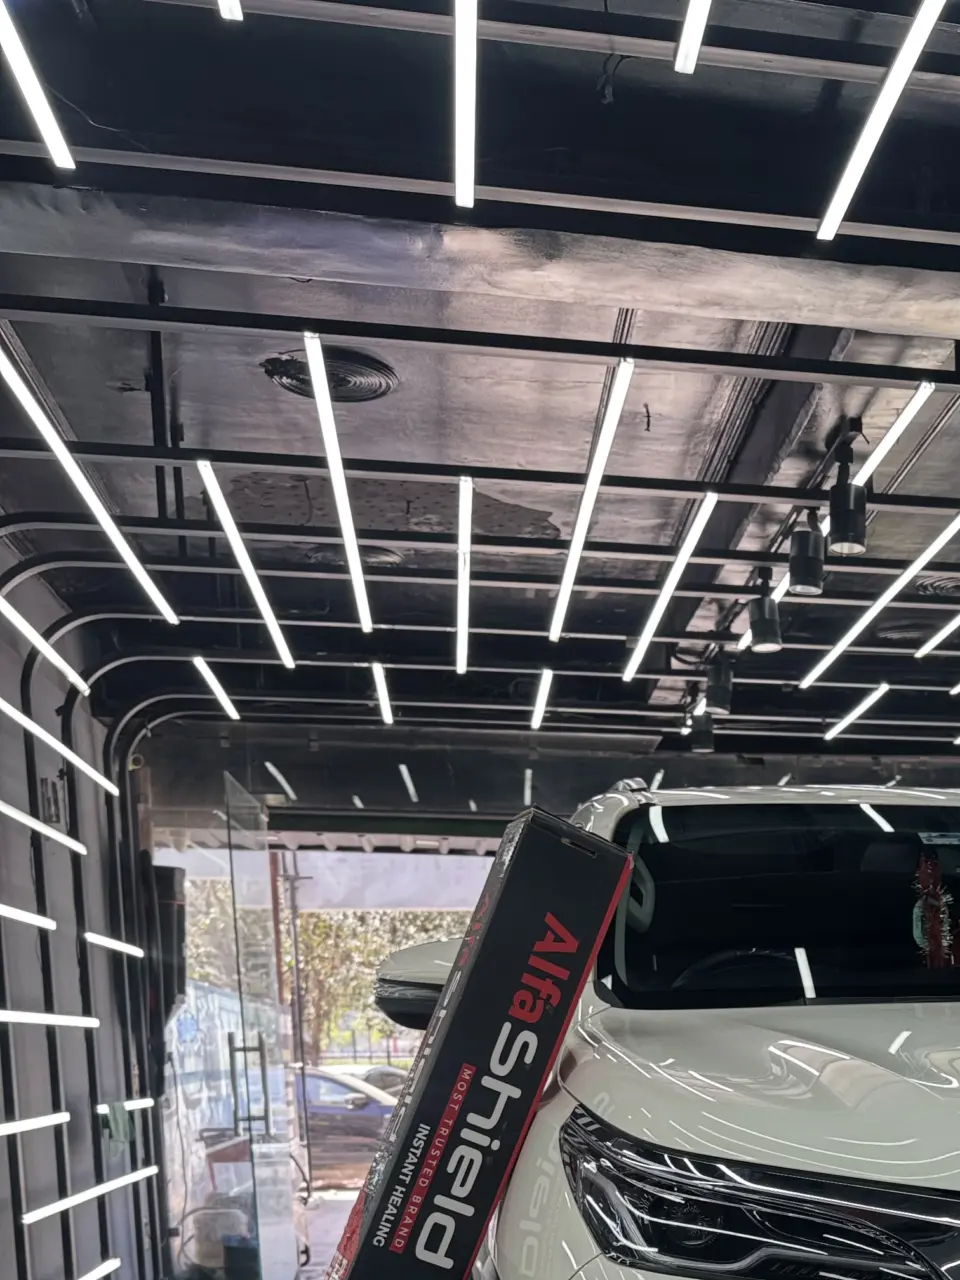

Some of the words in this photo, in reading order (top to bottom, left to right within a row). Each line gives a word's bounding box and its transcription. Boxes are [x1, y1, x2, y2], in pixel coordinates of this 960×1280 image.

[449, 1068, 472, 1111] MOST
[398, 1123, 431, 1184] INSTANT
[418, 1117, 454, 1187] TRUSTED
[372, 1184, 406, 1248] HEALING
[394, 1194, 423, 1248] BRAND
